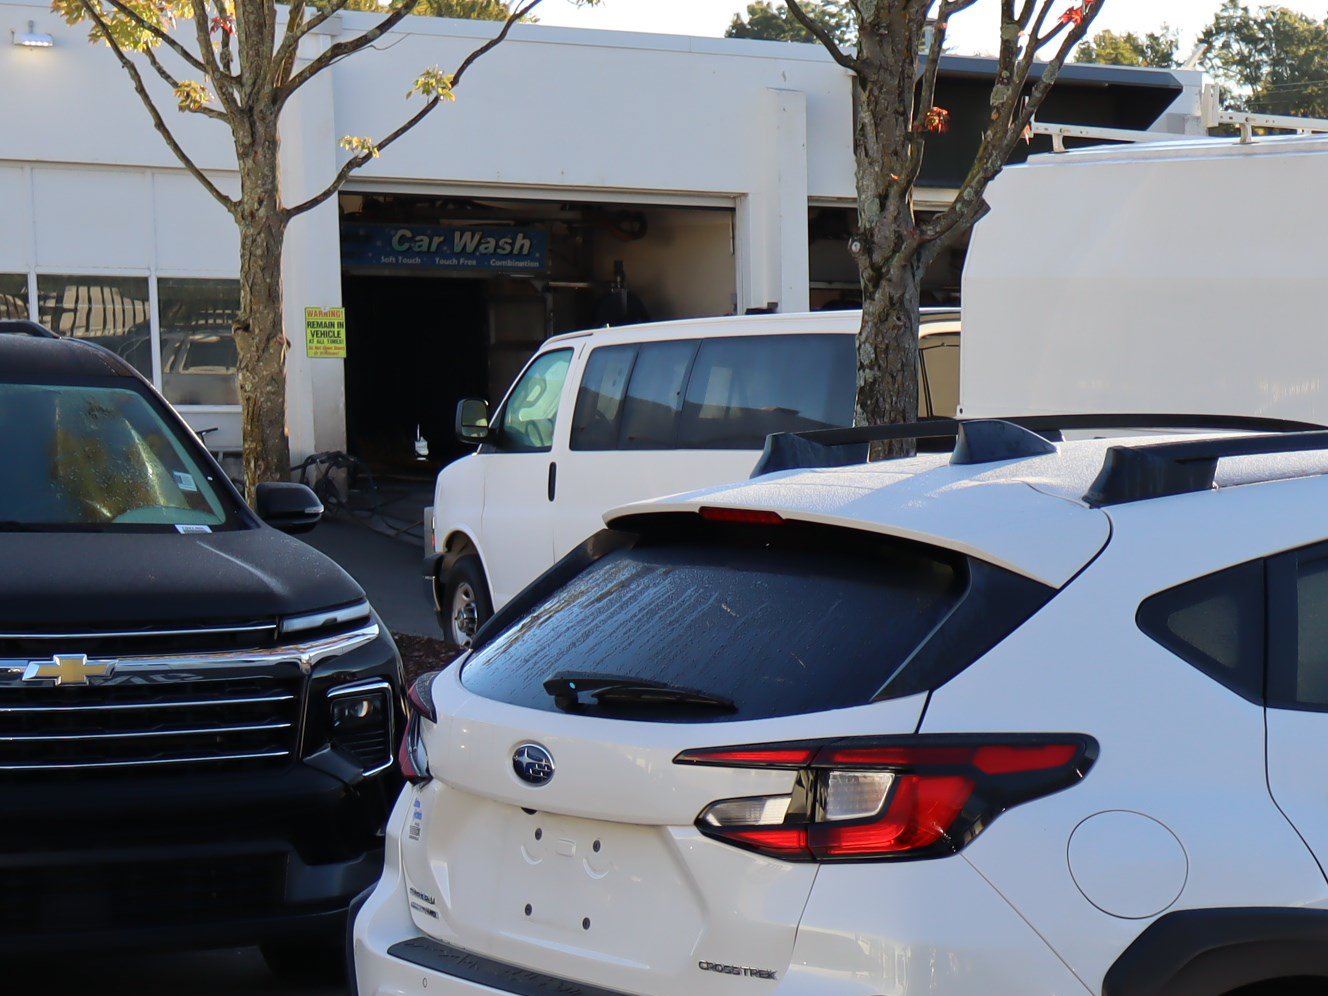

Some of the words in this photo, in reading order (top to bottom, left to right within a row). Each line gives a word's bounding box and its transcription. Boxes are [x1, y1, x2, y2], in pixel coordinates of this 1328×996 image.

[391, 229, 445, 253] Car
[453, 230, 532, 254] Wash
[381, 255, 396, 264] Soft
[398, 256, 421, 264] Touch
[435, 257, 458, 265] Touch
[459, 258, 477, 266] Free
[490, 258, 540, 268] Combination
[307, 321, 335, 329] REMAIN
[337, 321, 344, 329] IN
[310, 330, 342, 339] VEHICLE
[698, 960, 777, 980] CROSSTREK
